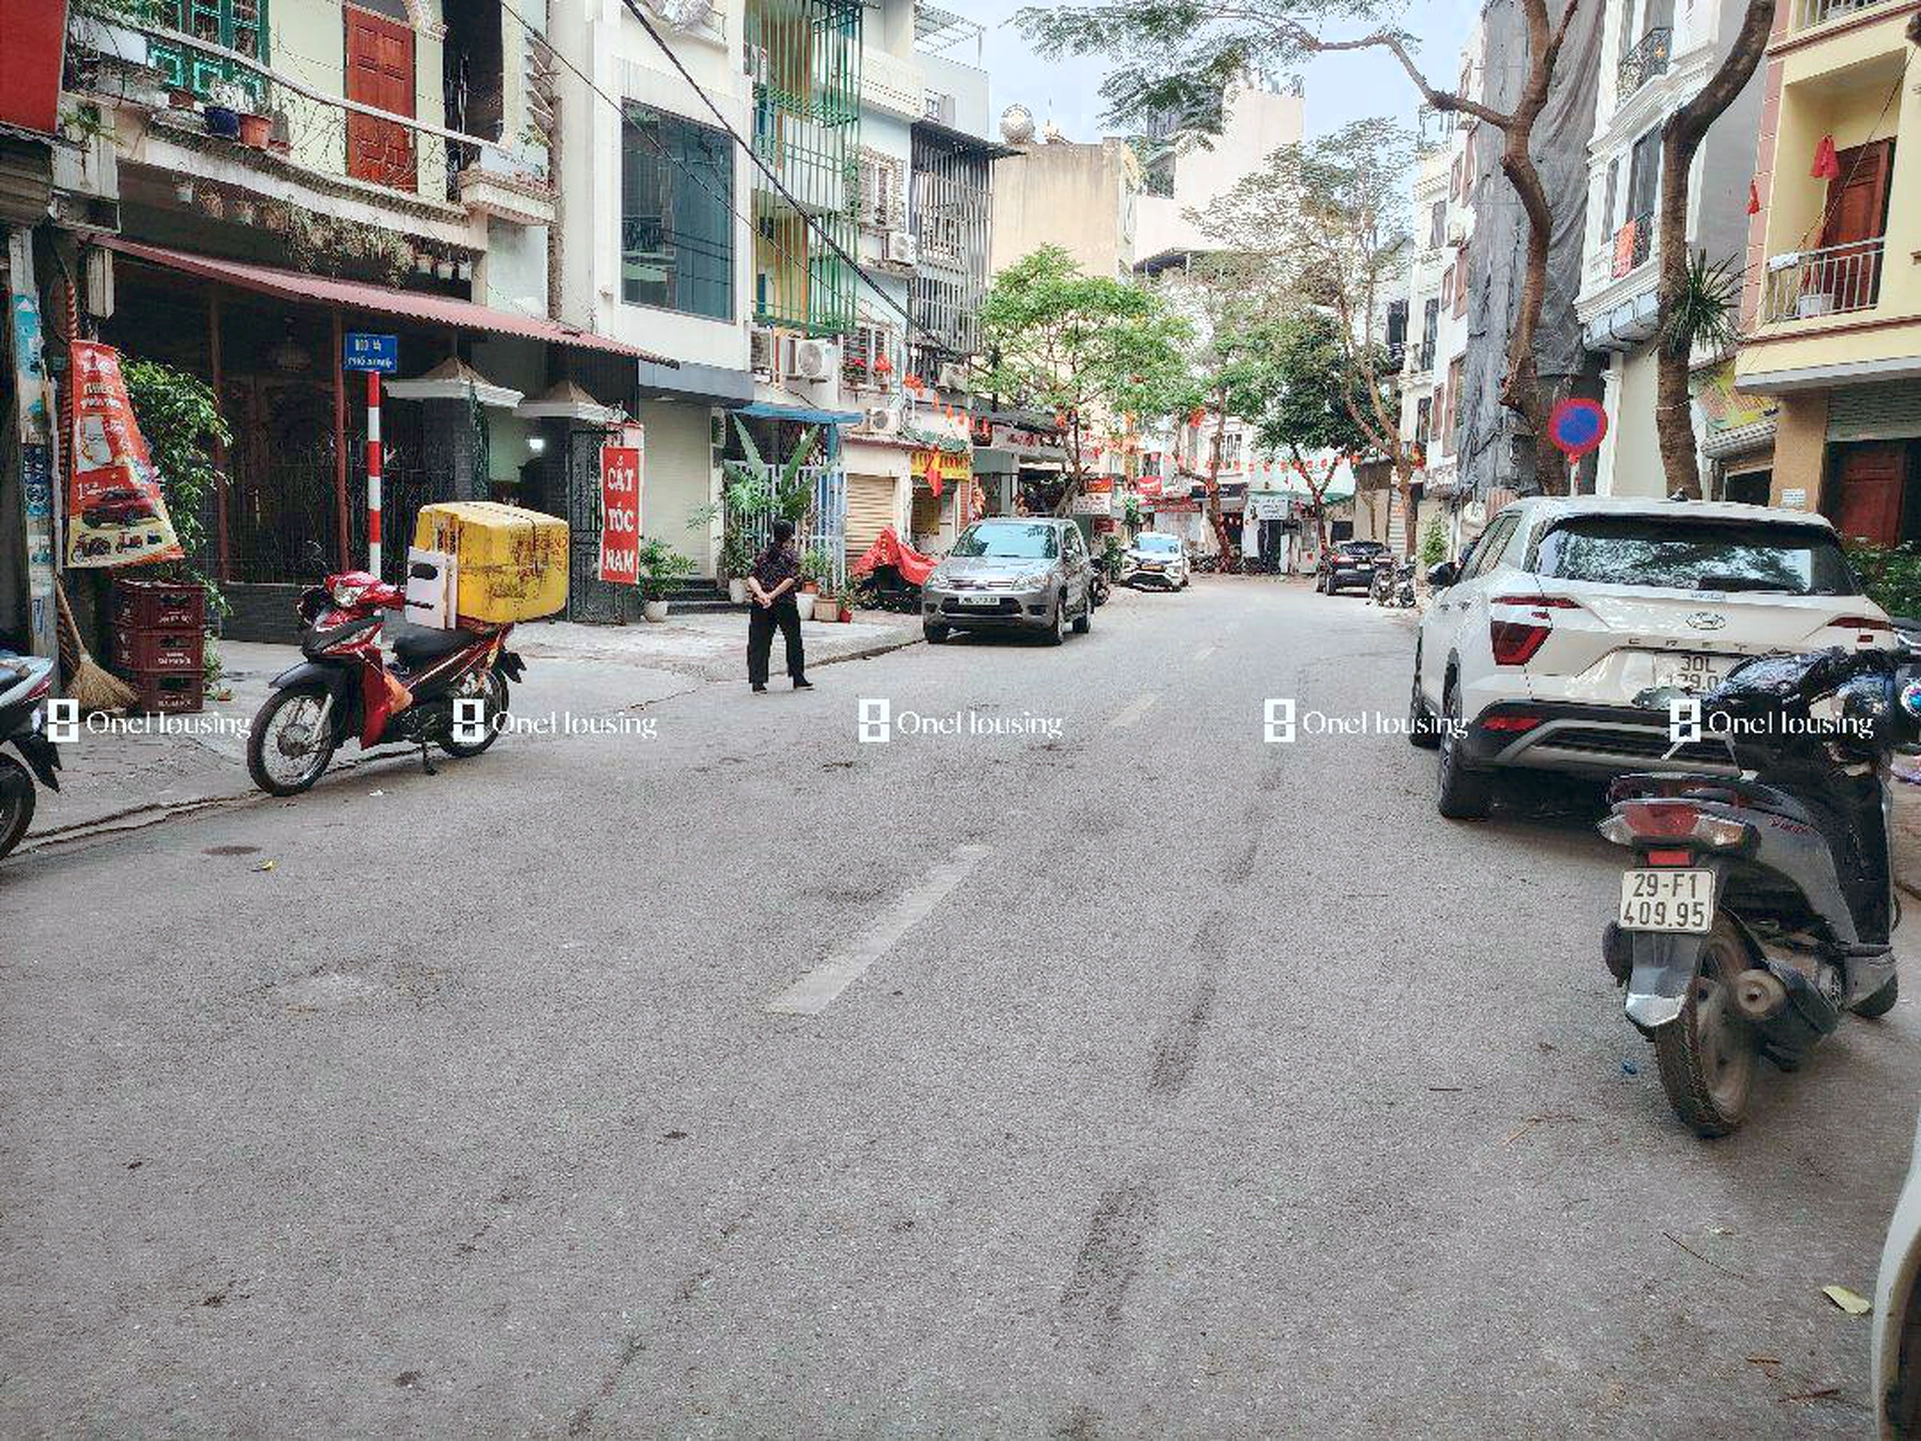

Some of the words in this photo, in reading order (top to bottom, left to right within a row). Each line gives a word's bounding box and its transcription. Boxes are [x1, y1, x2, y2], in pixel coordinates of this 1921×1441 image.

[608, 501, 635, 533] TÓC
[605, 548, 634, 573] NAM
[1680, 655, 1717, 673] 30L
[1632, 873, 1697, 899] 29-F1
[1623, 900, 1705, 927] 409.95
